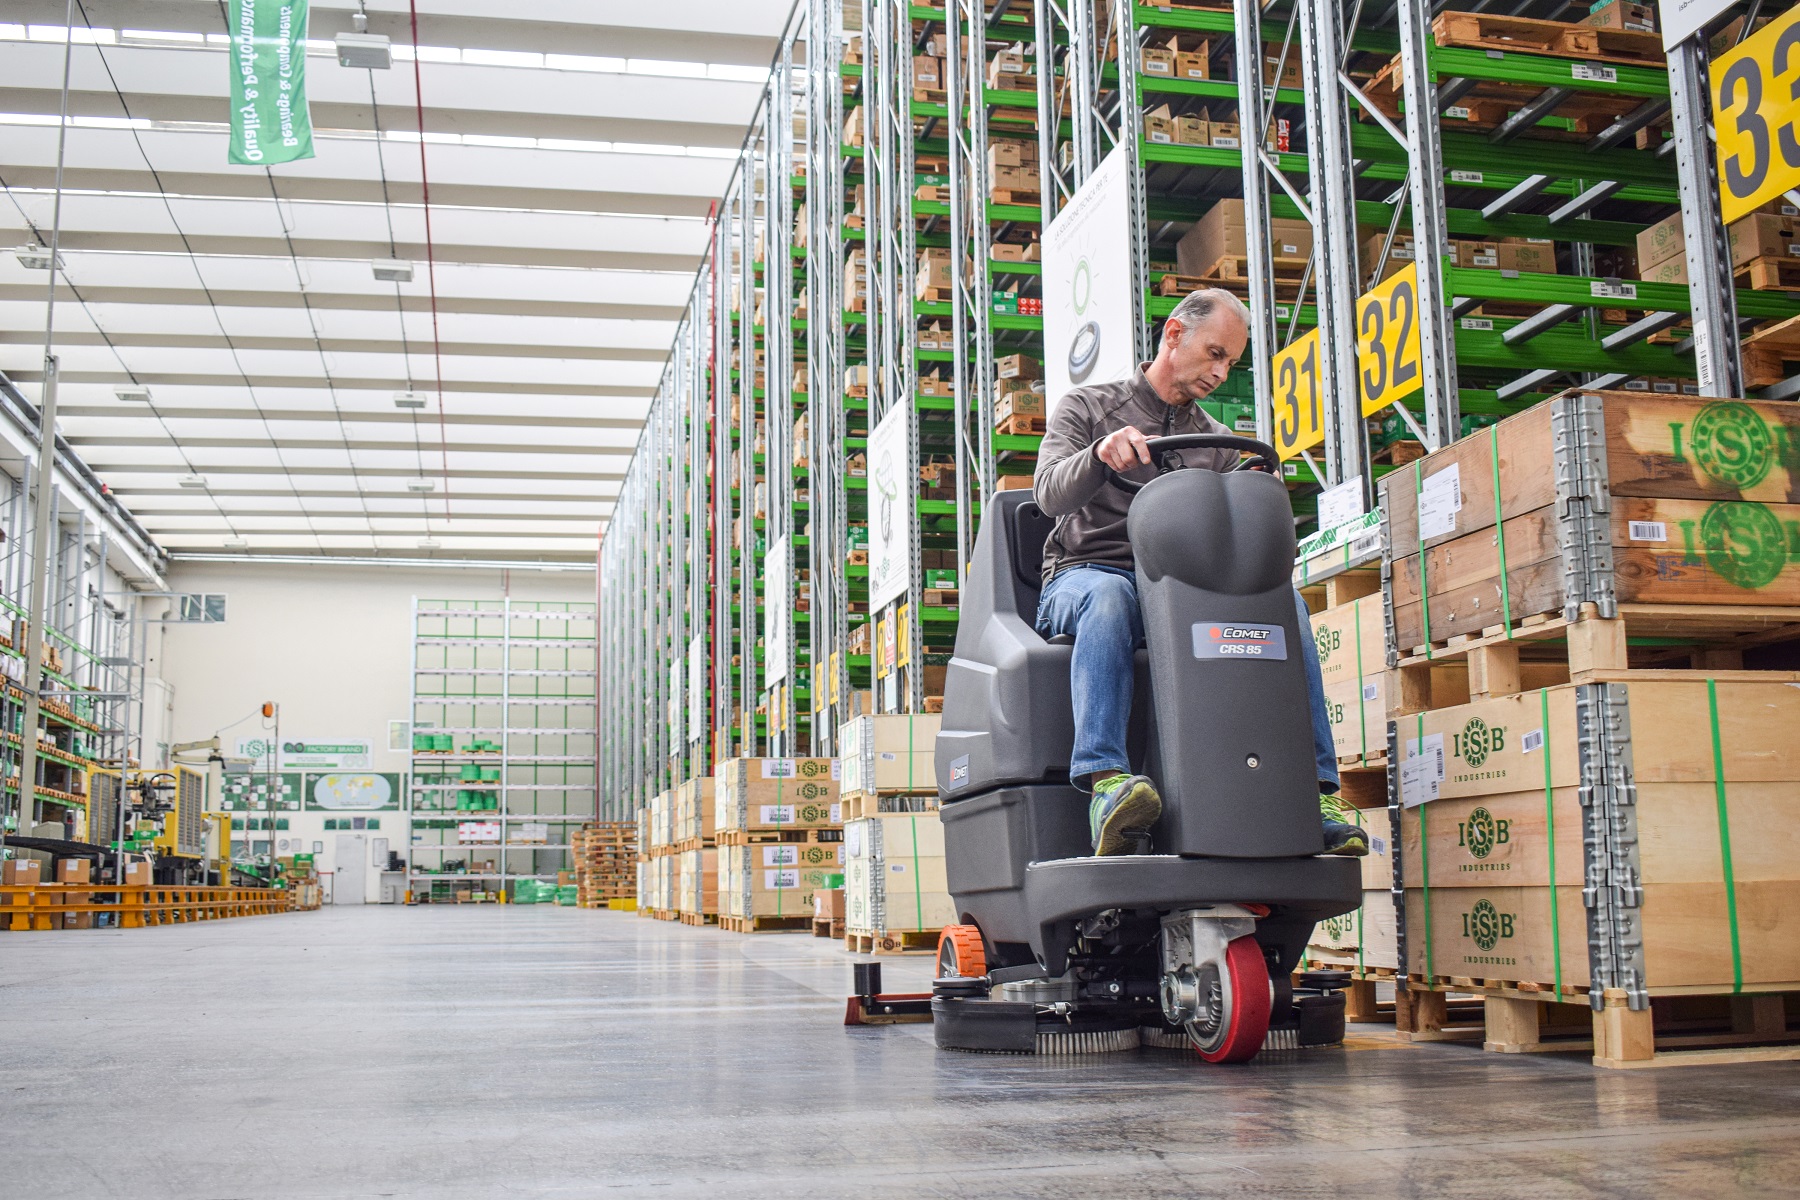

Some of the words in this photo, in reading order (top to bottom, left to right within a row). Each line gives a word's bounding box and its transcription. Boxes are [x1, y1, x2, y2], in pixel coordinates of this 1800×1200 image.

[1362, 281, 1417, 401] 32
[1280, 340, 1318, 447] 31
[1222, 627, 1270, 639] COMET
[1220, 644, 1245, 654] CRS
[1246, 645, 1262, 654] 85
[1453, 723, 1504, 761] ISB
[796, 762, 828, 776] ISB
[1454, 770, 1506, 782] INDUSTRIES
[796, 808, 828, 820] ISB
[1458, 814, 1510, 852] ISB
[802, 849, 833, 862] ISB
[1458, 863, 1510, 872] INDUSTRIES
[1462, 907, 1514, 944] ISB
[1464, 956, 1516, 965] INDUSTRIES
